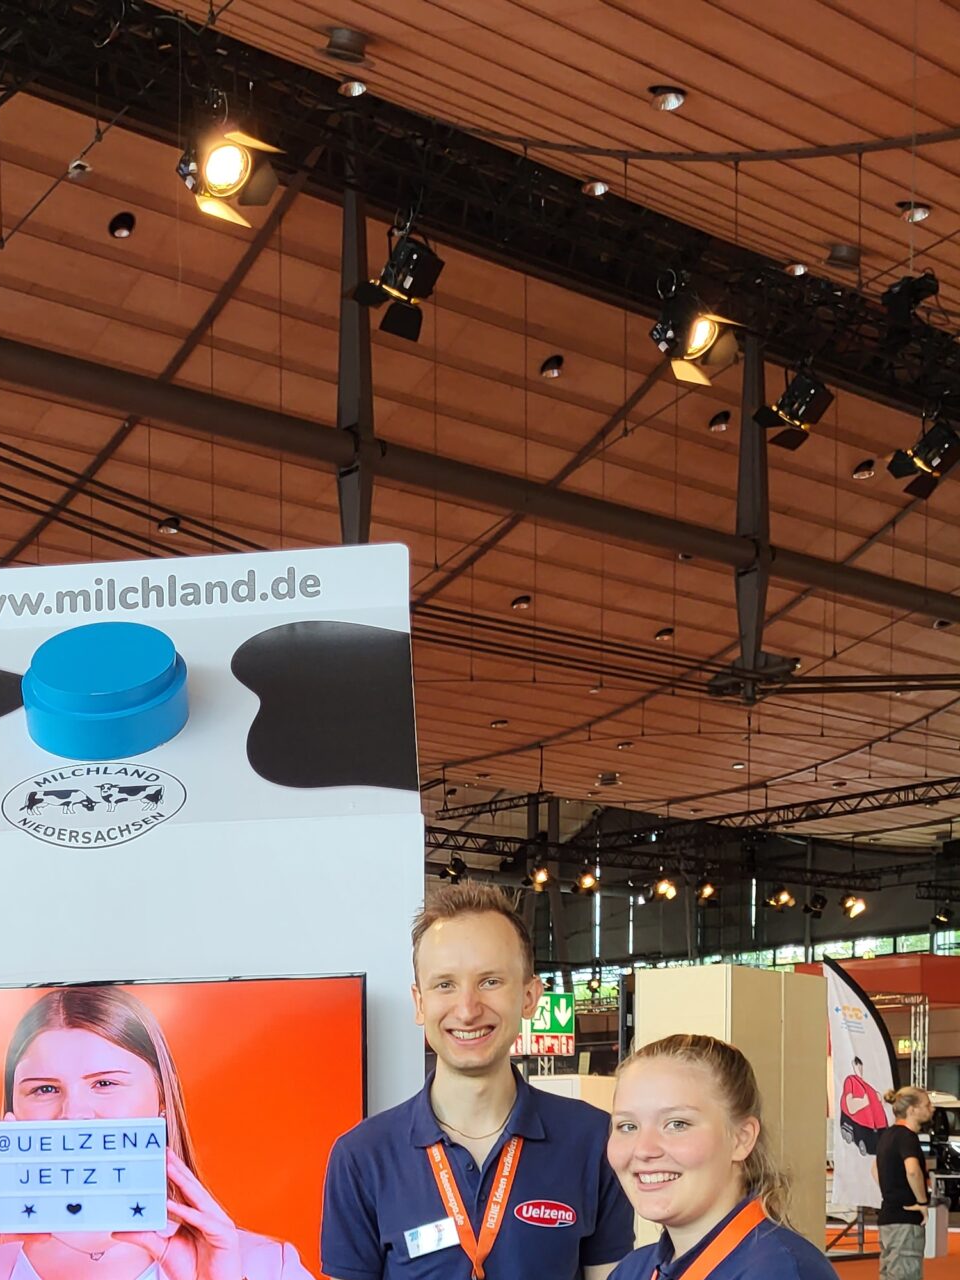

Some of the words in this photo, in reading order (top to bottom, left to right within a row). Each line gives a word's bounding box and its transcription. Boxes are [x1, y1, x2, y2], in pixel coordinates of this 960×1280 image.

[33, 766, 160, 788] MILCHLAND
[17, 811, 166, 844] NIEDERSACHSEN
[486, 1203, 500, 1229] DEINE
[494, 1177, 508, 1203] Ideen
[522, 1205, 573, 1221] Uelzena
